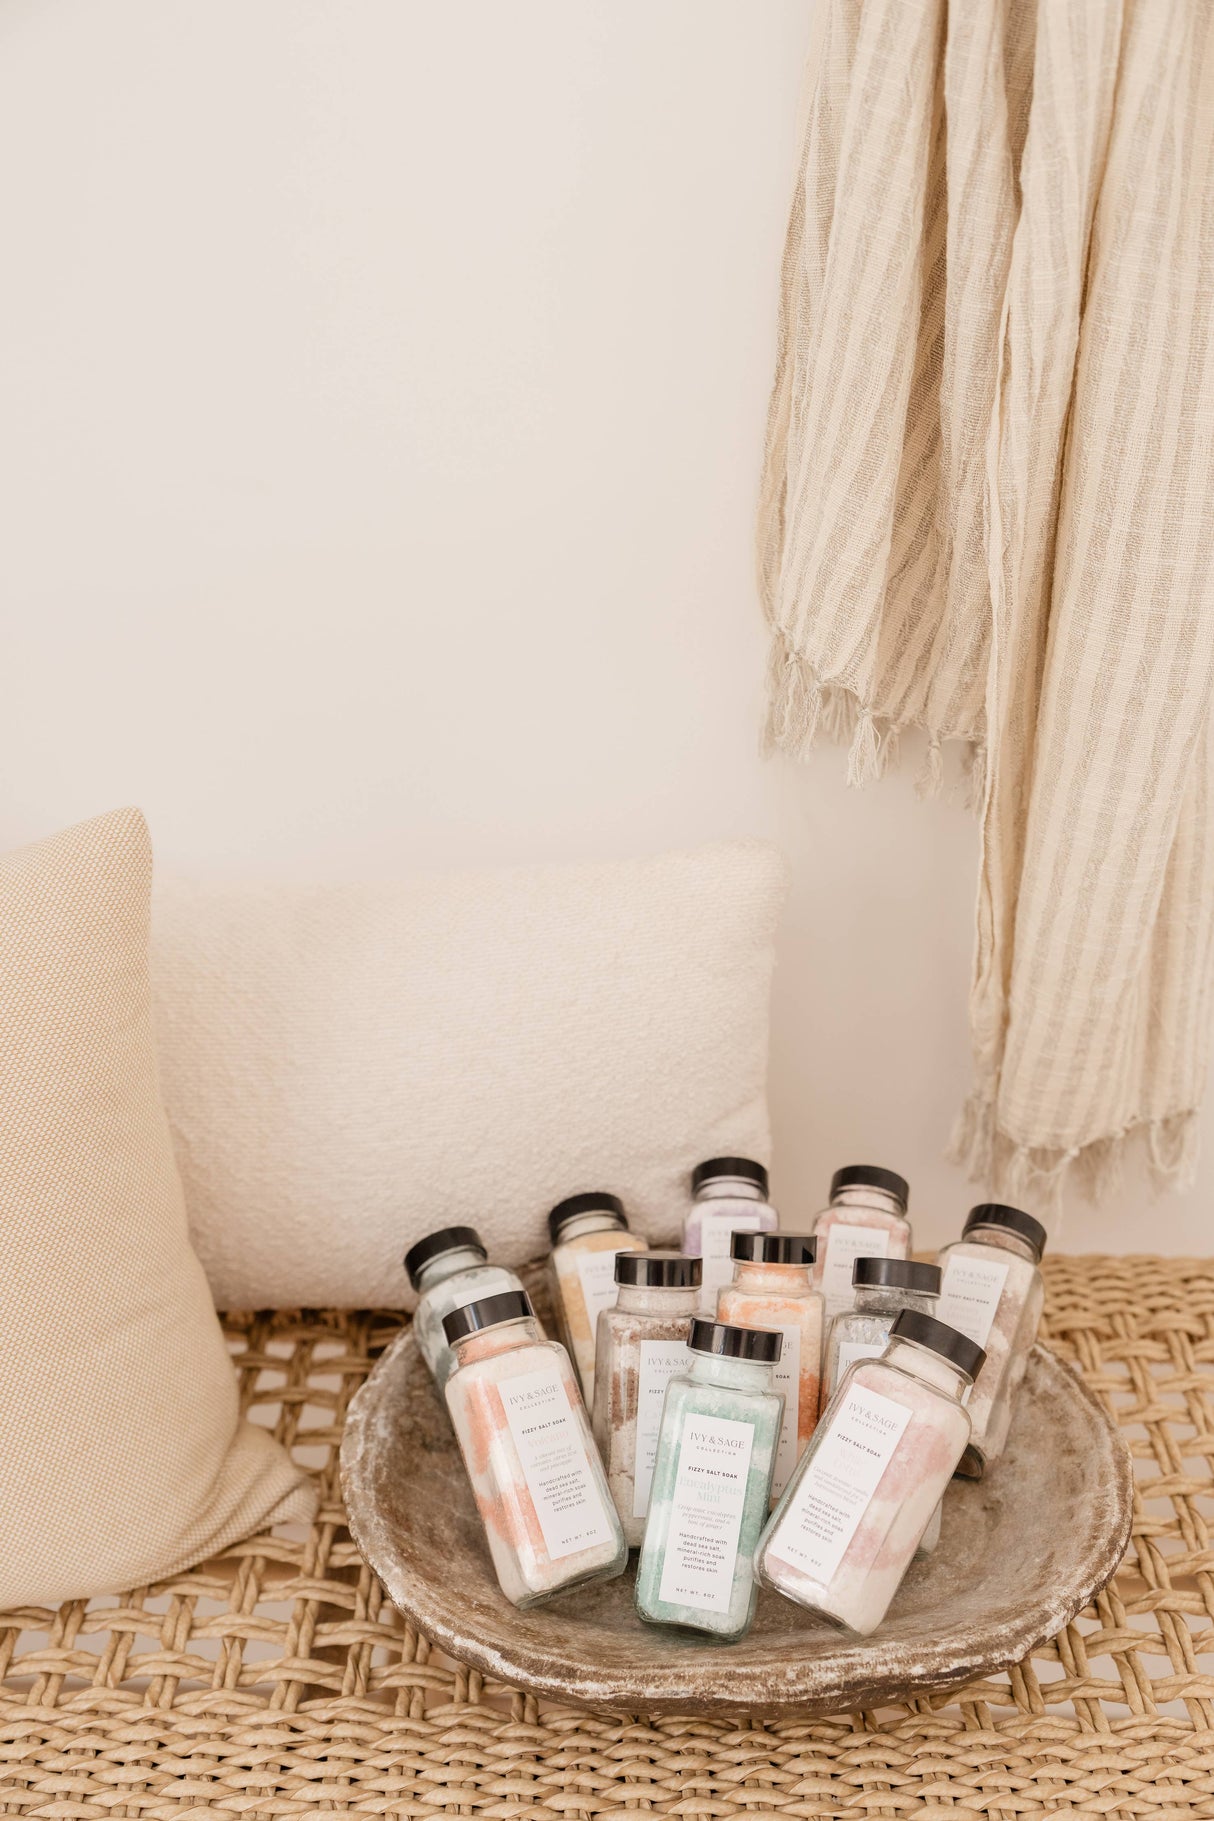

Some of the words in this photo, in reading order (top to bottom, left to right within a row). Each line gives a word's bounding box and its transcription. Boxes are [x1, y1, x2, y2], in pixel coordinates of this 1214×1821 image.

[648, 1358, 663, 1366] IVY
[509, 1393, 526, 1406] IVY
[526, 1392, 534, 1400] &
[534, 1384, 560, 1398] SAGE
[520, 1397, 556, 1411] COLLECTION
[848, 1402, 864, 1416] IVY
[864, 1410, 872, 1419] &
[872, 1414, 898, 1432] SAGE
[522, 1426, 537, 1435] FIZZY
[538, 1422, 552, 1430] SALT
[552, 1418, 566, 1426] SOAK
[851, 1416, 888, 1436] COLLECTION
[690, 1432, 706, 1442] IVY
[708, 1436, 716, 1444] &
[717, 1437, 744, 1449] SAGE
[837, 1433, 852, 1443] FIZZY
[853, 1440, 866, 1450] SALT
[866, 1448, 882, 1458] SOAK
[696, 1445, 736, 1456] COLLECTION
[539, 1473, 570, 1487] Handcrafted
[571, 1470, 582, 1478] with
[688, 1466, 705, 1474] FIZZY
[722, 1472, 738, 1480] SOAK
[546, 1484, 558, 1493] dead
[569, 1478, 580, 1486] salt,
[678, 1476, 743, 1496] Eucalyptus
[544, 1488, 574, 1500] mineral-rich
[552, 1496, 572, 1506] purifies
[572, 1492, 582, 1500] and
[554, 1502, 575, 1512] restores
[576, 1498, 586, 1506] skin
[808, 1494, 839, 1513] Handcrafted
[840, 1510, 850, 1519] with
[810, 1503, 821, 1512] dead
[822, 1510, 831, 1518] sea
[802, 1508, 830, 1526] mineral-rich
[832, 1524, 844, 1532] soak
[804, 1518, 823, 1530] purifies
[824, 1528, 834, 1536] and
[679, 1532, 714, 1543] Handcrafted
[800, 1524, 821, 1538] restores
[682, 1540, 697, 1548] dead
[676, 1547, 710, 1557] mineral-rich
[682, 1563, 705, 1572] restores
[683, 1556, 705, 1565] purifies
